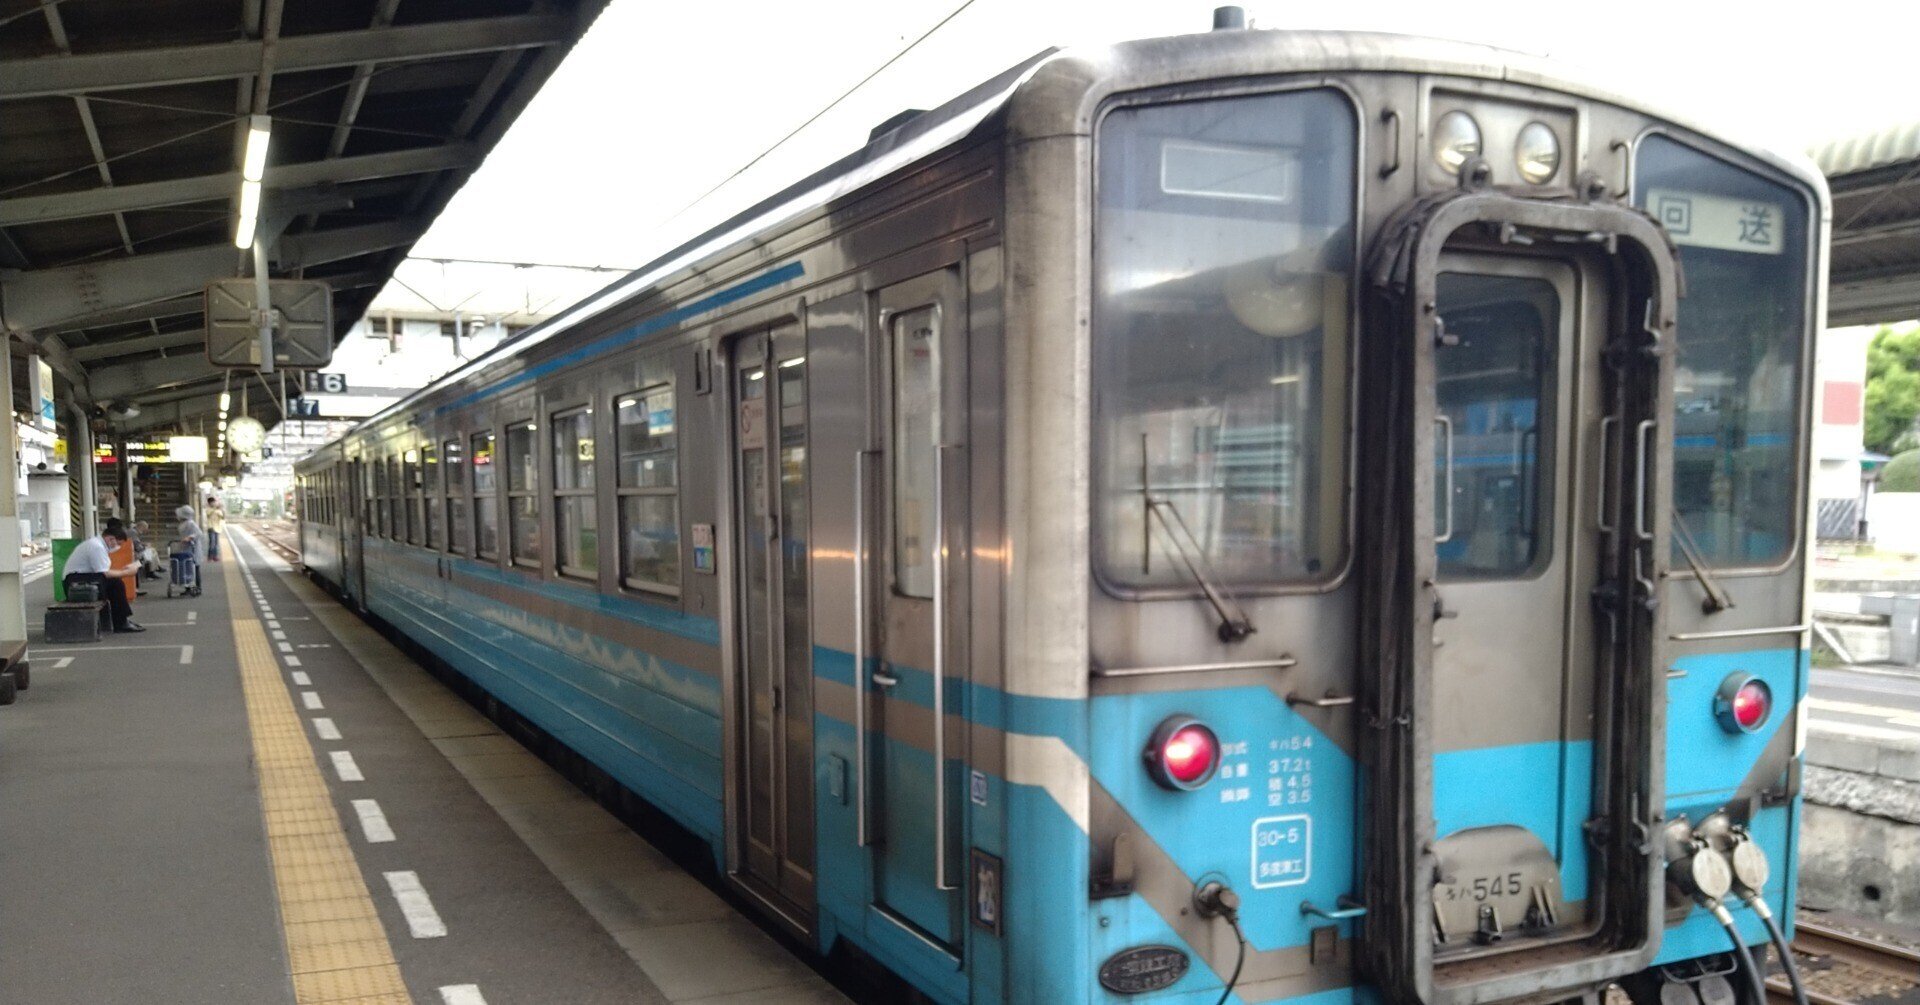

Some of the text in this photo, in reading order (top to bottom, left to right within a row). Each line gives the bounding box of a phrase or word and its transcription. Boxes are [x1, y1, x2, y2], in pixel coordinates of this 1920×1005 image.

[1659, 197, 1771, 245] 回送
[324, 373, 342, 393] 6
[303, 400, 316, 415] 7
